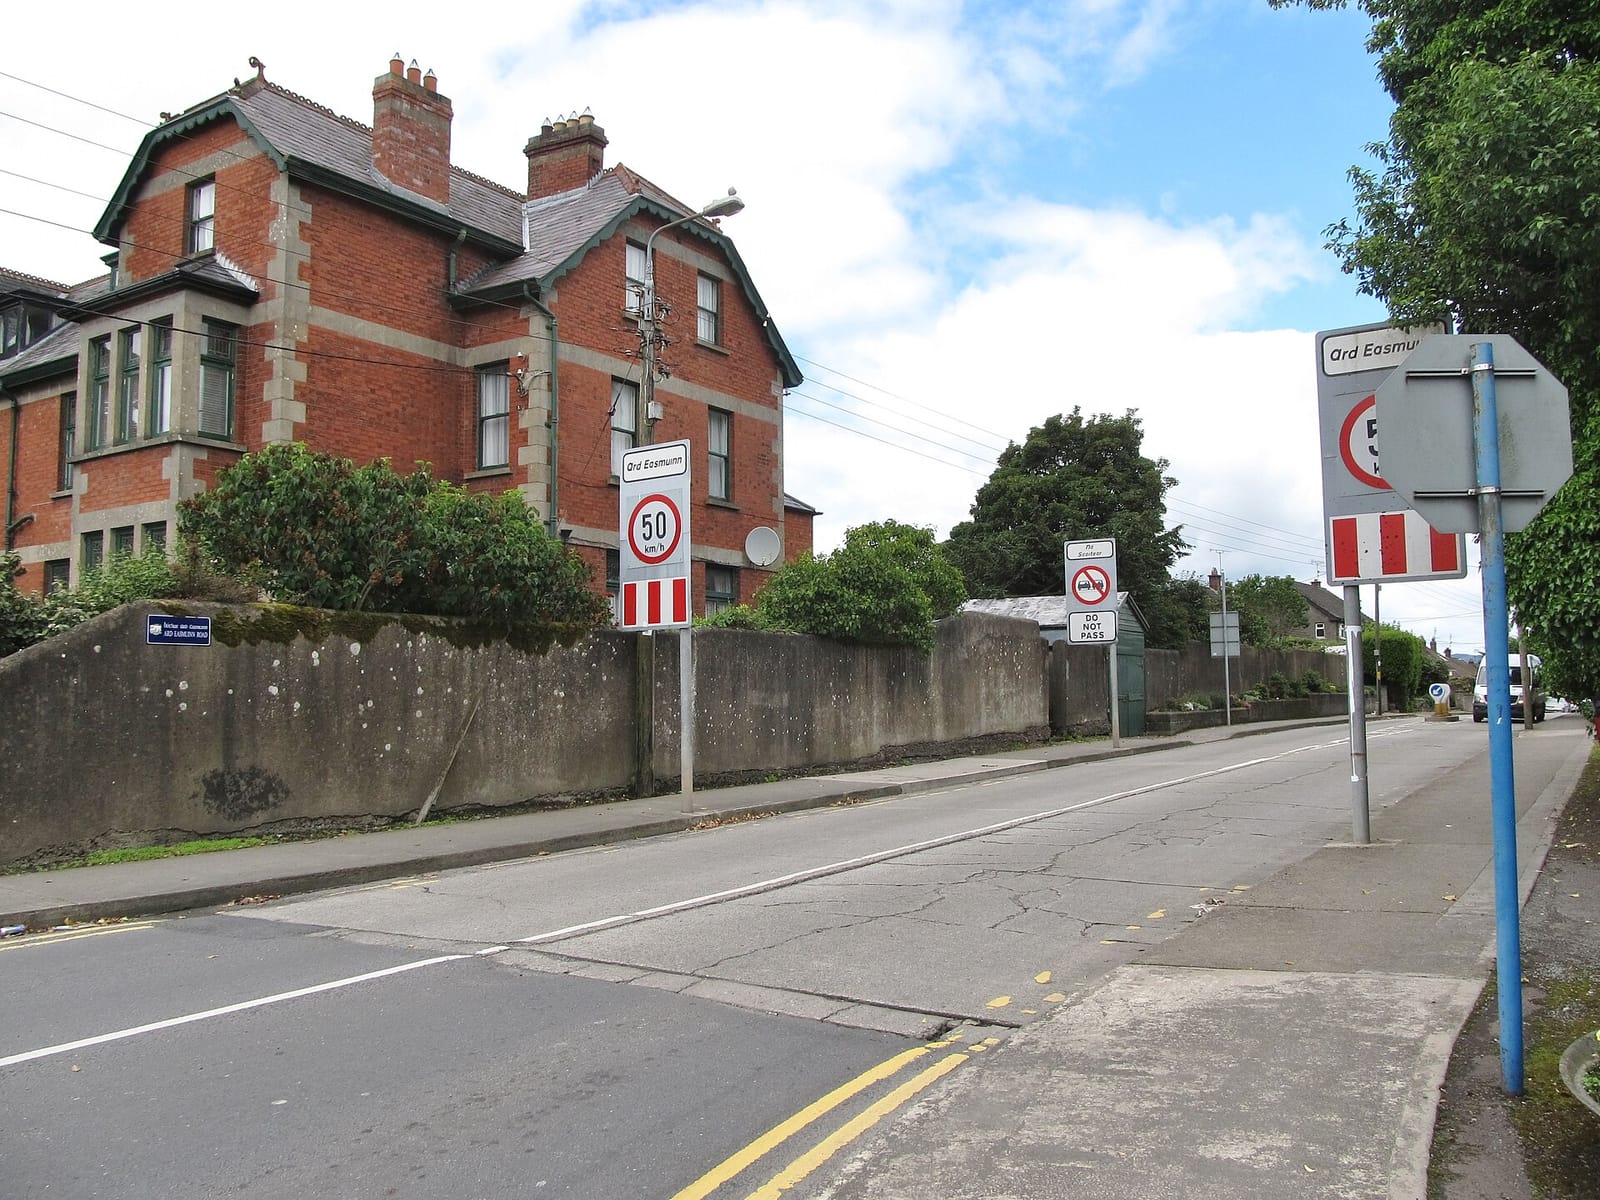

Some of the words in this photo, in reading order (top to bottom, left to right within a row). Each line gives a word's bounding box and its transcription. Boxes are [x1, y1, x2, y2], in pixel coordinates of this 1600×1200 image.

[1366, 418, 1379, 457] 5
[642, 511, 666, 541] 50
[644, 543, 665, 554] km/h
[1085, 614, 1099, 622] DO
[1082, 622, 1102, 631] NOT
[196, 631, 209, 639] ROAD
[1080, 631, 1105, 640] PASS
